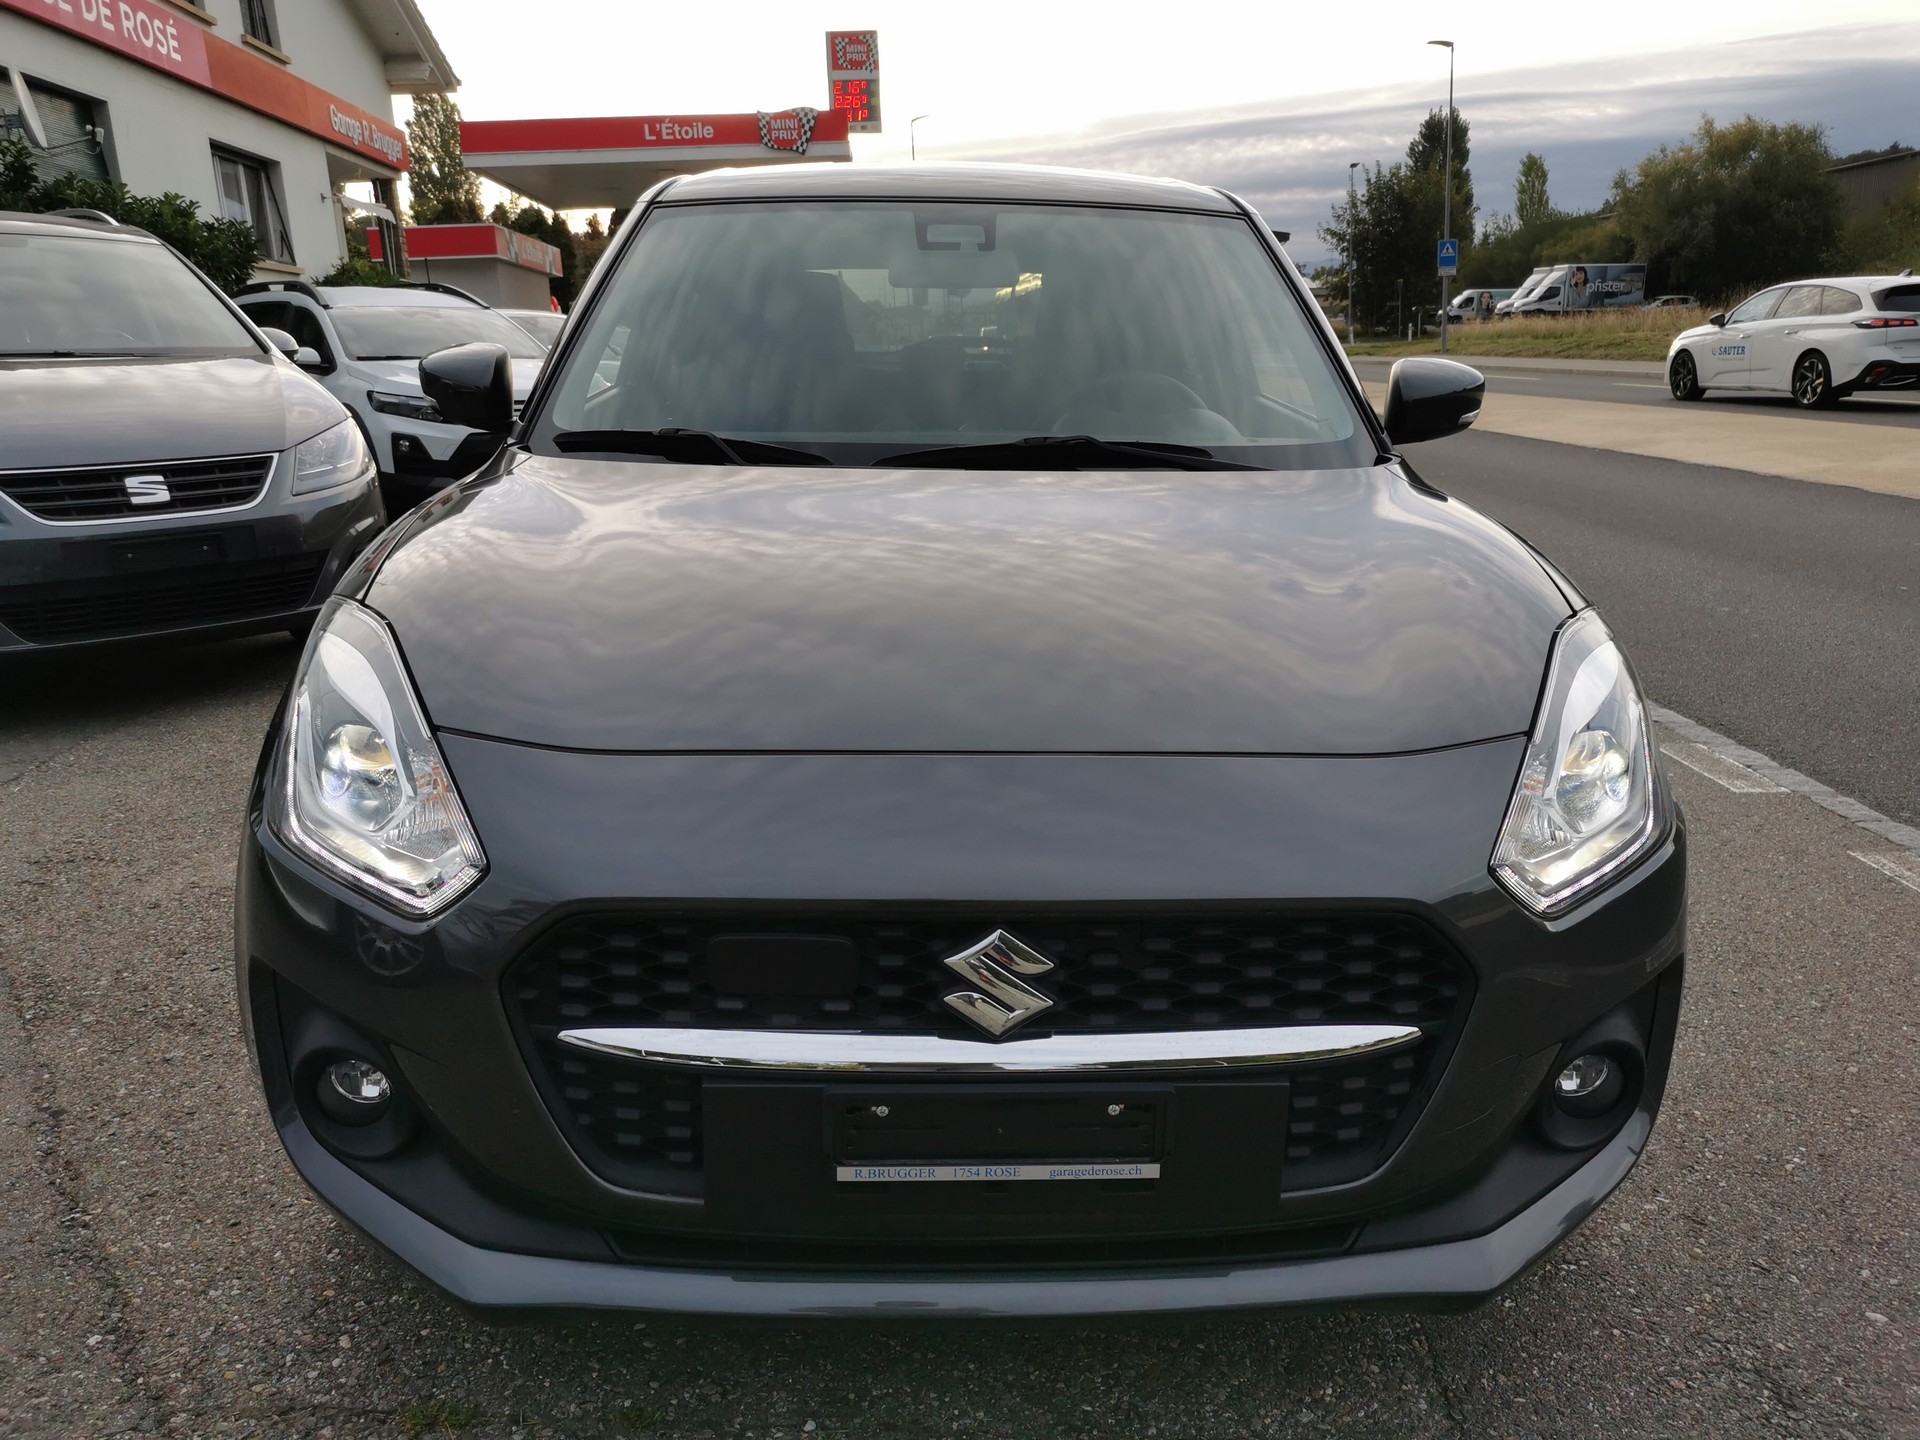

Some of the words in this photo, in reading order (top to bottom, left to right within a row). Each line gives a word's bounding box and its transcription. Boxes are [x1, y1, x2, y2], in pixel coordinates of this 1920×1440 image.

[119, 2, 182, 62] ROSÉ
[846, 44, 867, 53] MINI
[846, 53, 868, 62] PRIX
[329, 104, 362, 147] Garage
[644, 119, 714, 141] L'Étoile
[770, 119, 799, 130] MINI
[771, 130, 799, 141] PRIX
[1585, 279, 1626, 297] pfister
[1718, 345, 1746, 356] SAUTER
[854, 1168, 936, 1179] R.BRUGGER
[953, 1168, 980, 1178] 1754
[985, 1167, 1021, 1178] ROSE
[1049, 1165, 1142, 1179] garagederose.ch
